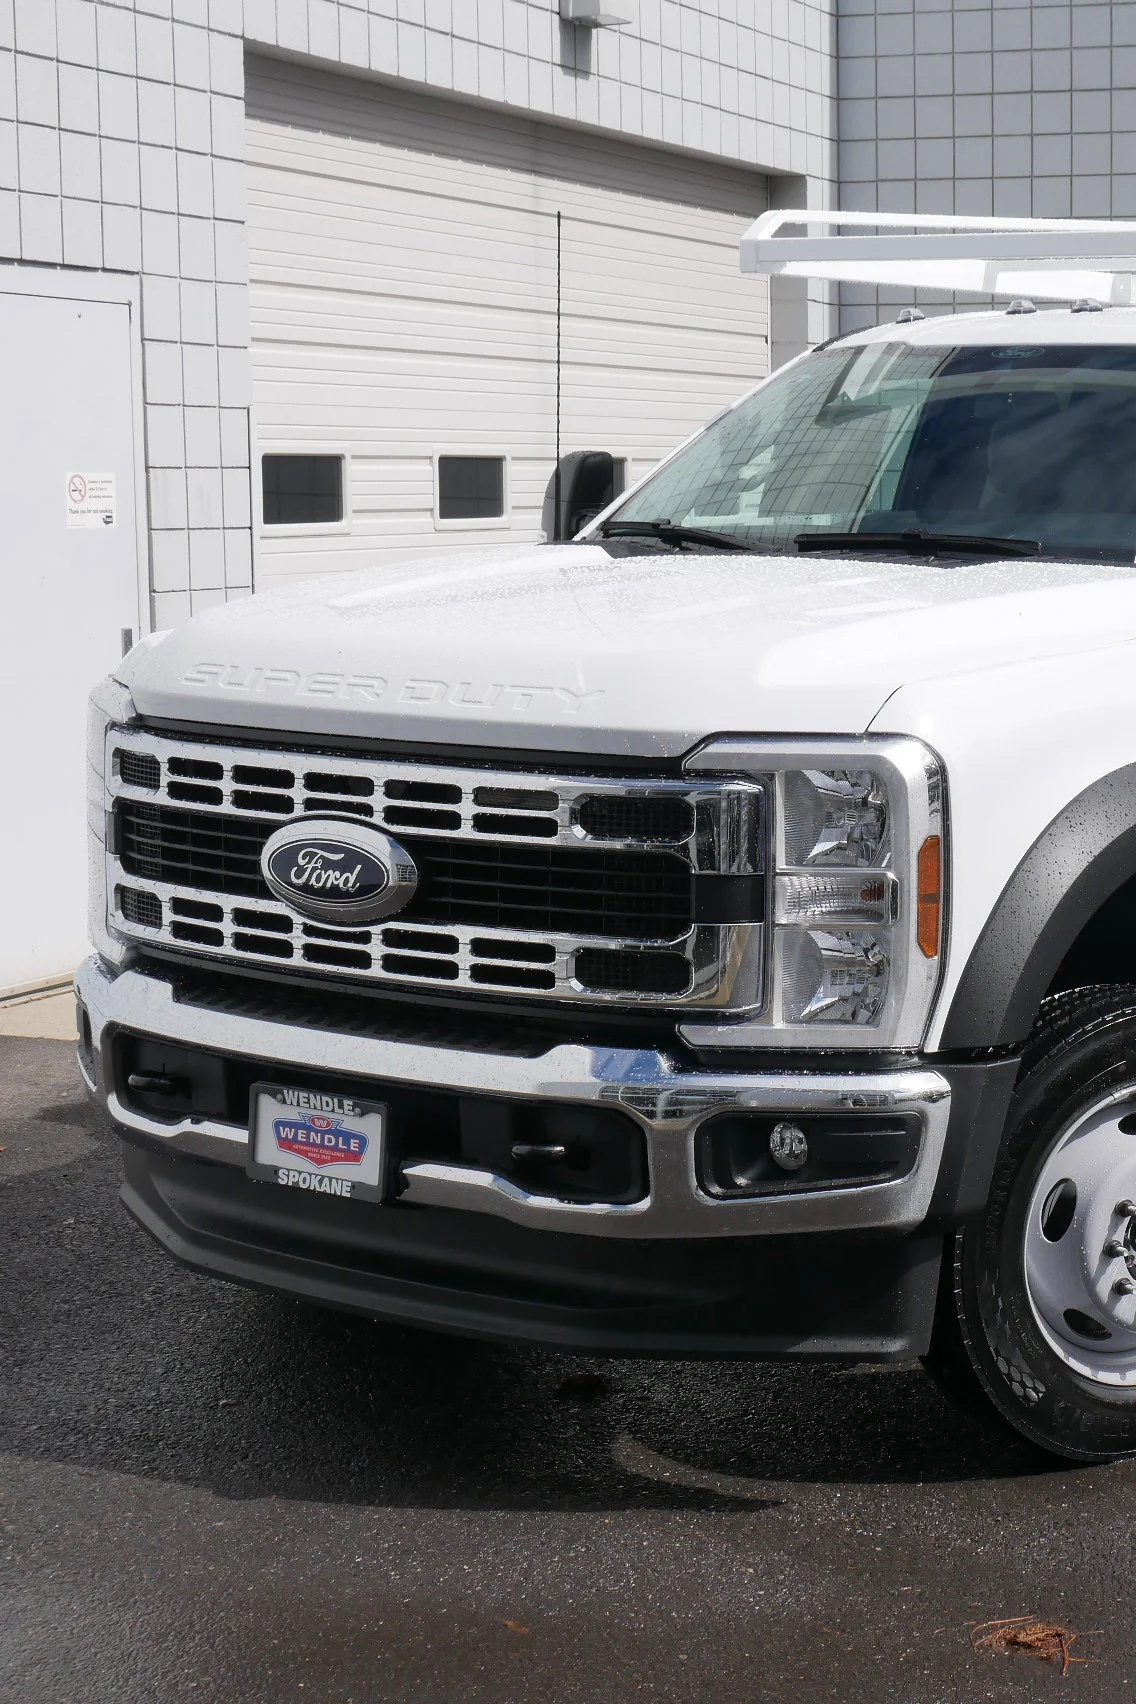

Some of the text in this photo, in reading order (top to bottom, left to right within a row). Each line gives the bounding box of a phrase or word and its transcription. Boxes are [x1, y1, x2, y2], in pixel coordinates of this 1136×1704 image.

[180, 663, 606, 714] SUPER DUTY
[290, 847, 361, 894] Ford
[283, 1089, 354, 1117] WENDLE
[280, 1126, 360, 1151] WENDLE
[277, 1168, 351, 1198] SPOKANE
